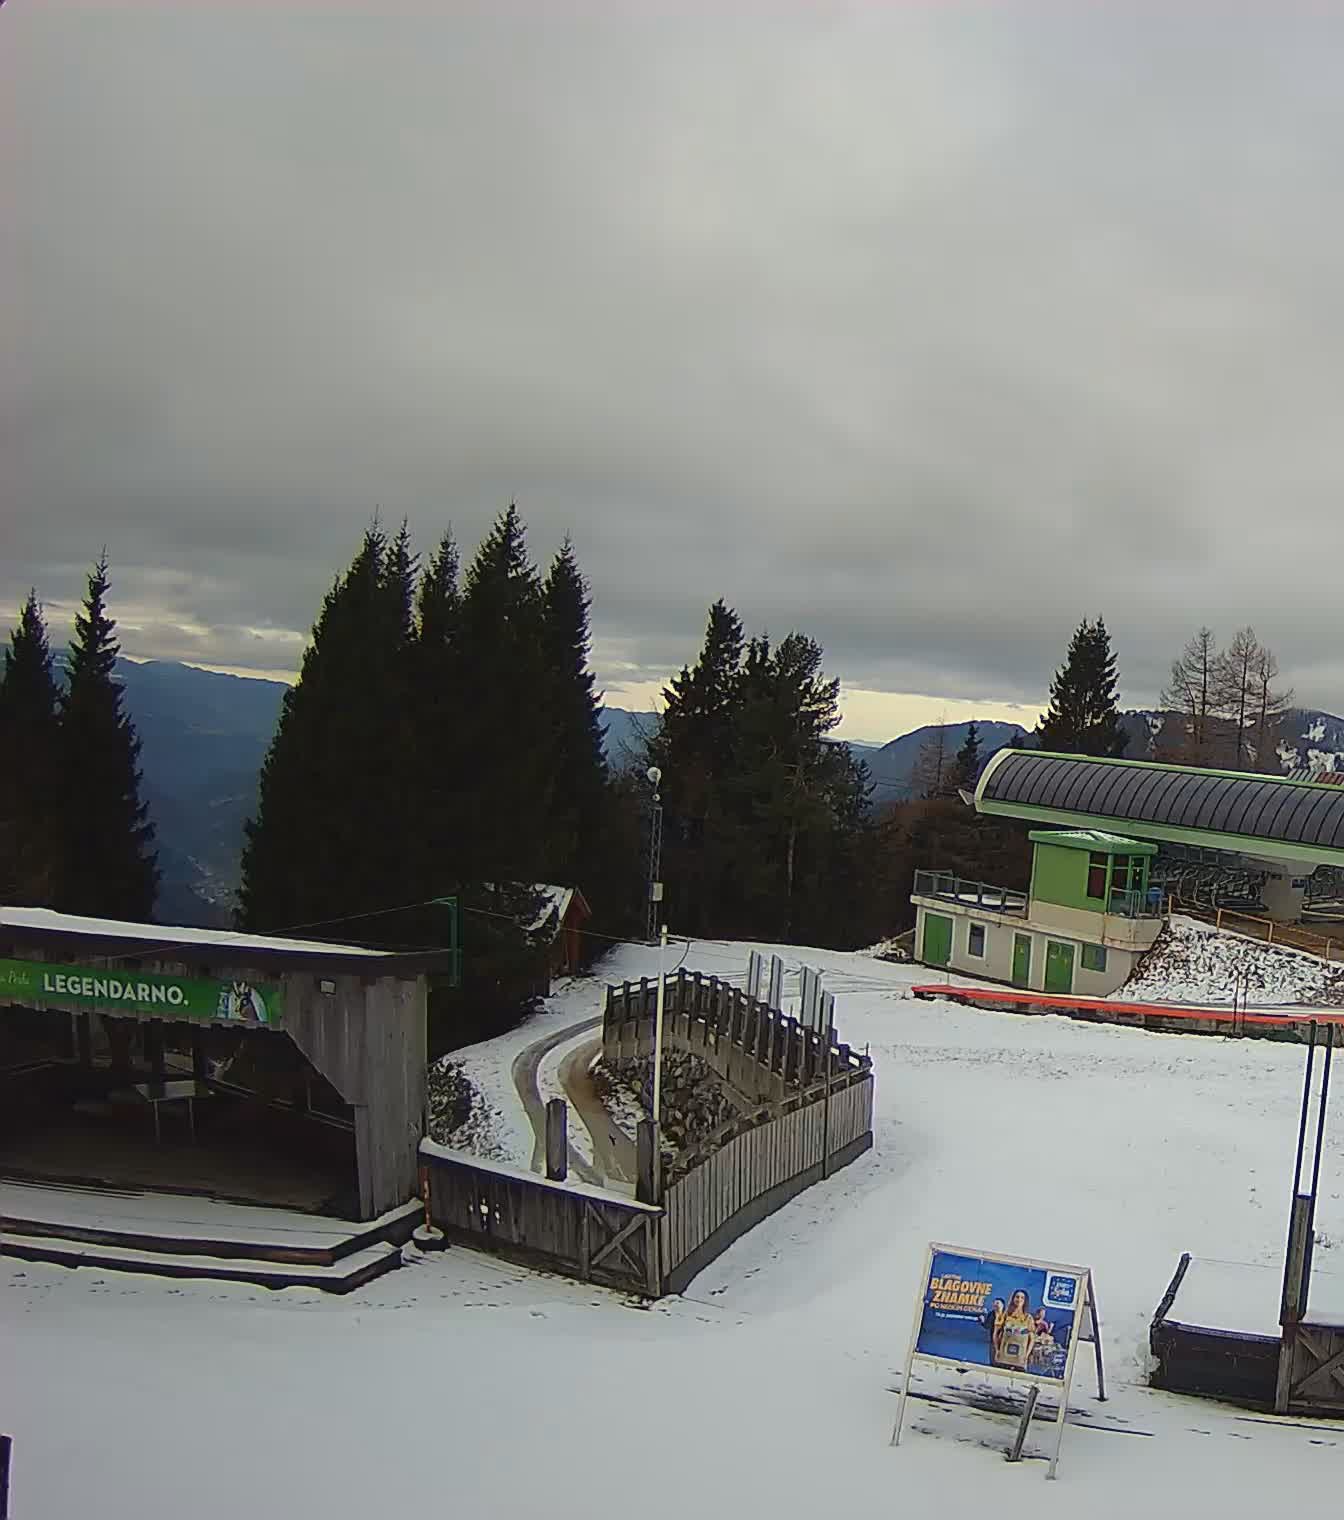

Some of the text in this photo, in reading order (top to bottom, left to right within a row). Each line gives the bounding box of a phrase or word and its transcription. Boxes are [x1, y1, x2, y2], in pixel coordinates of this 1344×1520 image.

[43, 972, 190, 1006] LEGENDARNO.
[930, 1277, 993, 1295] BLAGOVNE
[932, 1290, 985, 1307] ZNAMKE
